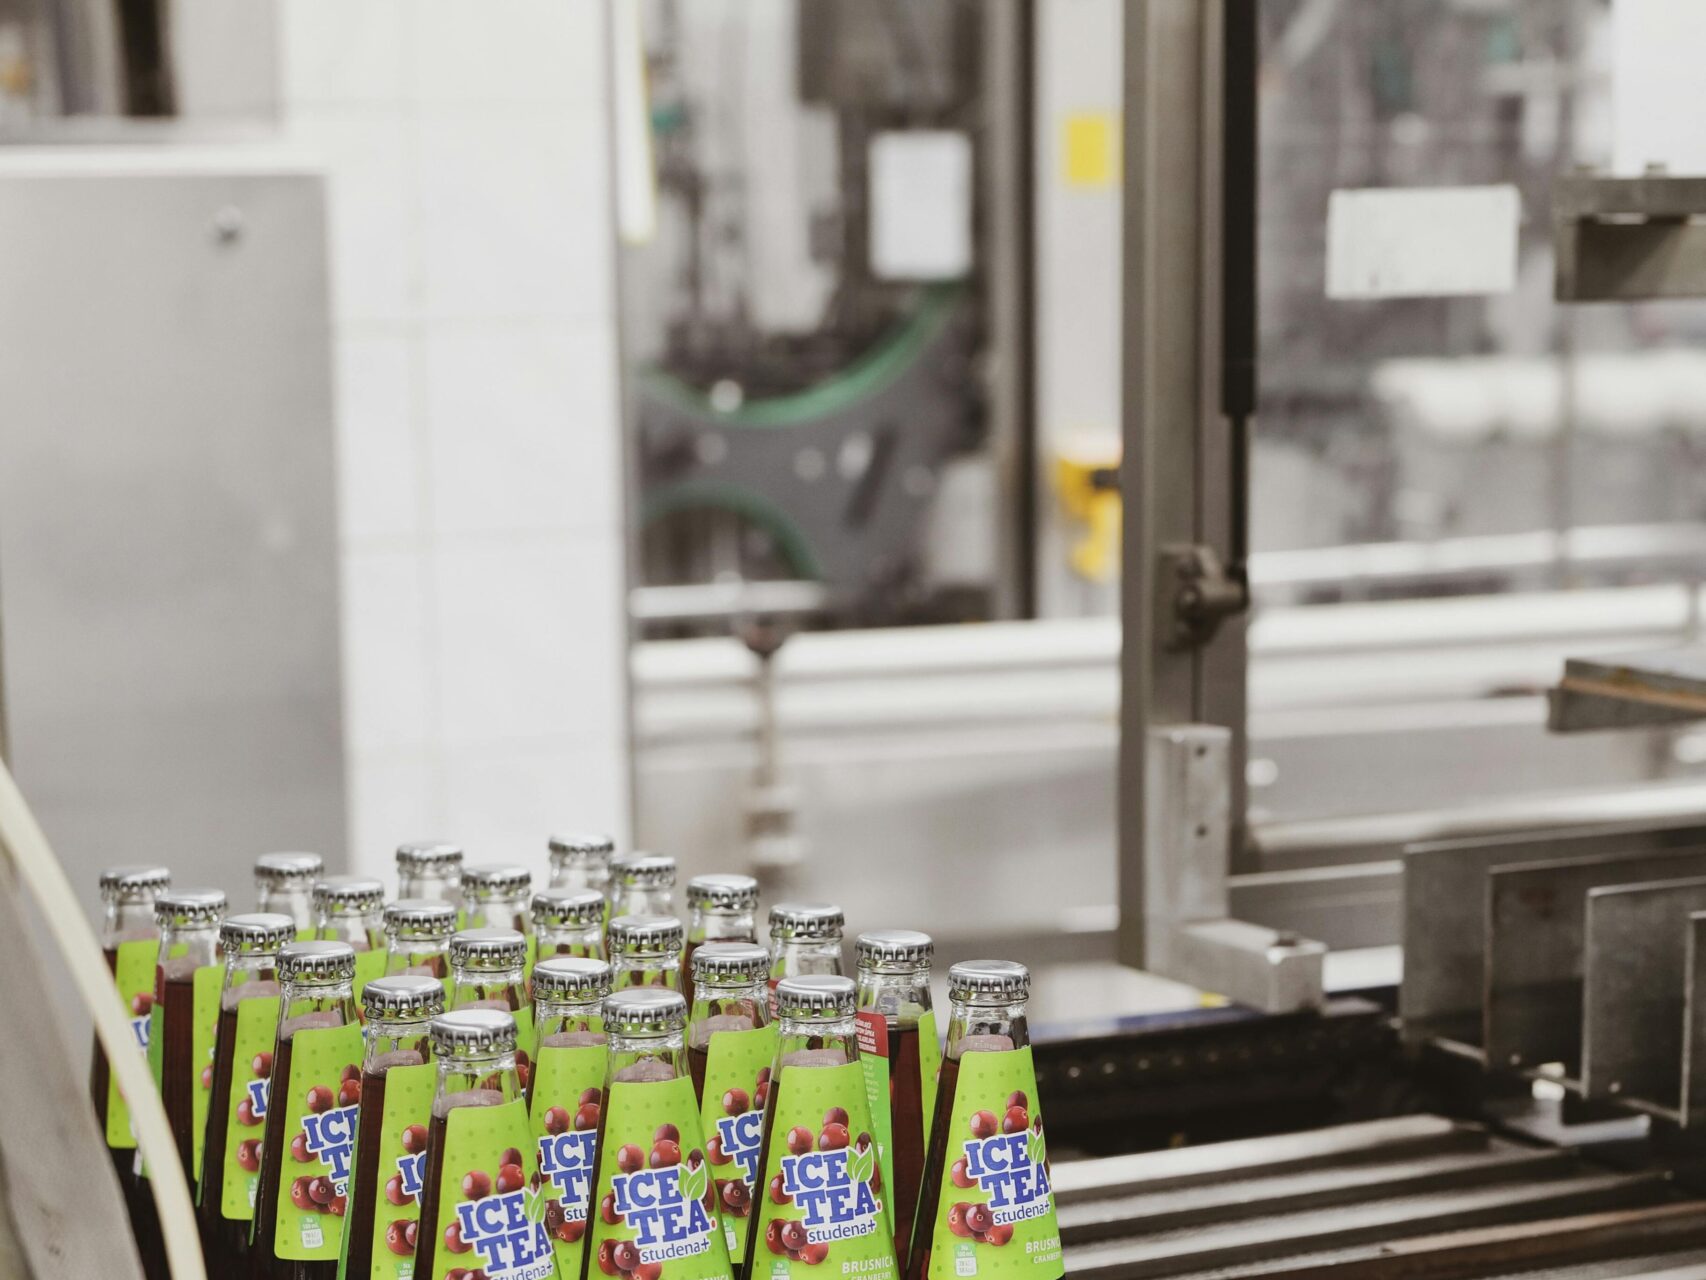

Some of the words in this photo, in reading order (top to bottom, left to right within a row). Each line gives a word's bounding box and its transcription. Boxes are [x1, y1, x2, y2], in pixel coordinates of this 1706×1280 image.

[718, 1113, 763, 1153] IC
[782, 1151, 851, 1192] ICE
[965, 1134, 1031, 1176] ICE
[613, 1169, 683, 1212] ICE
[458, 1193, 528, 1240] ICE
[842, 1255, 894, 1274] BRUSNICA
